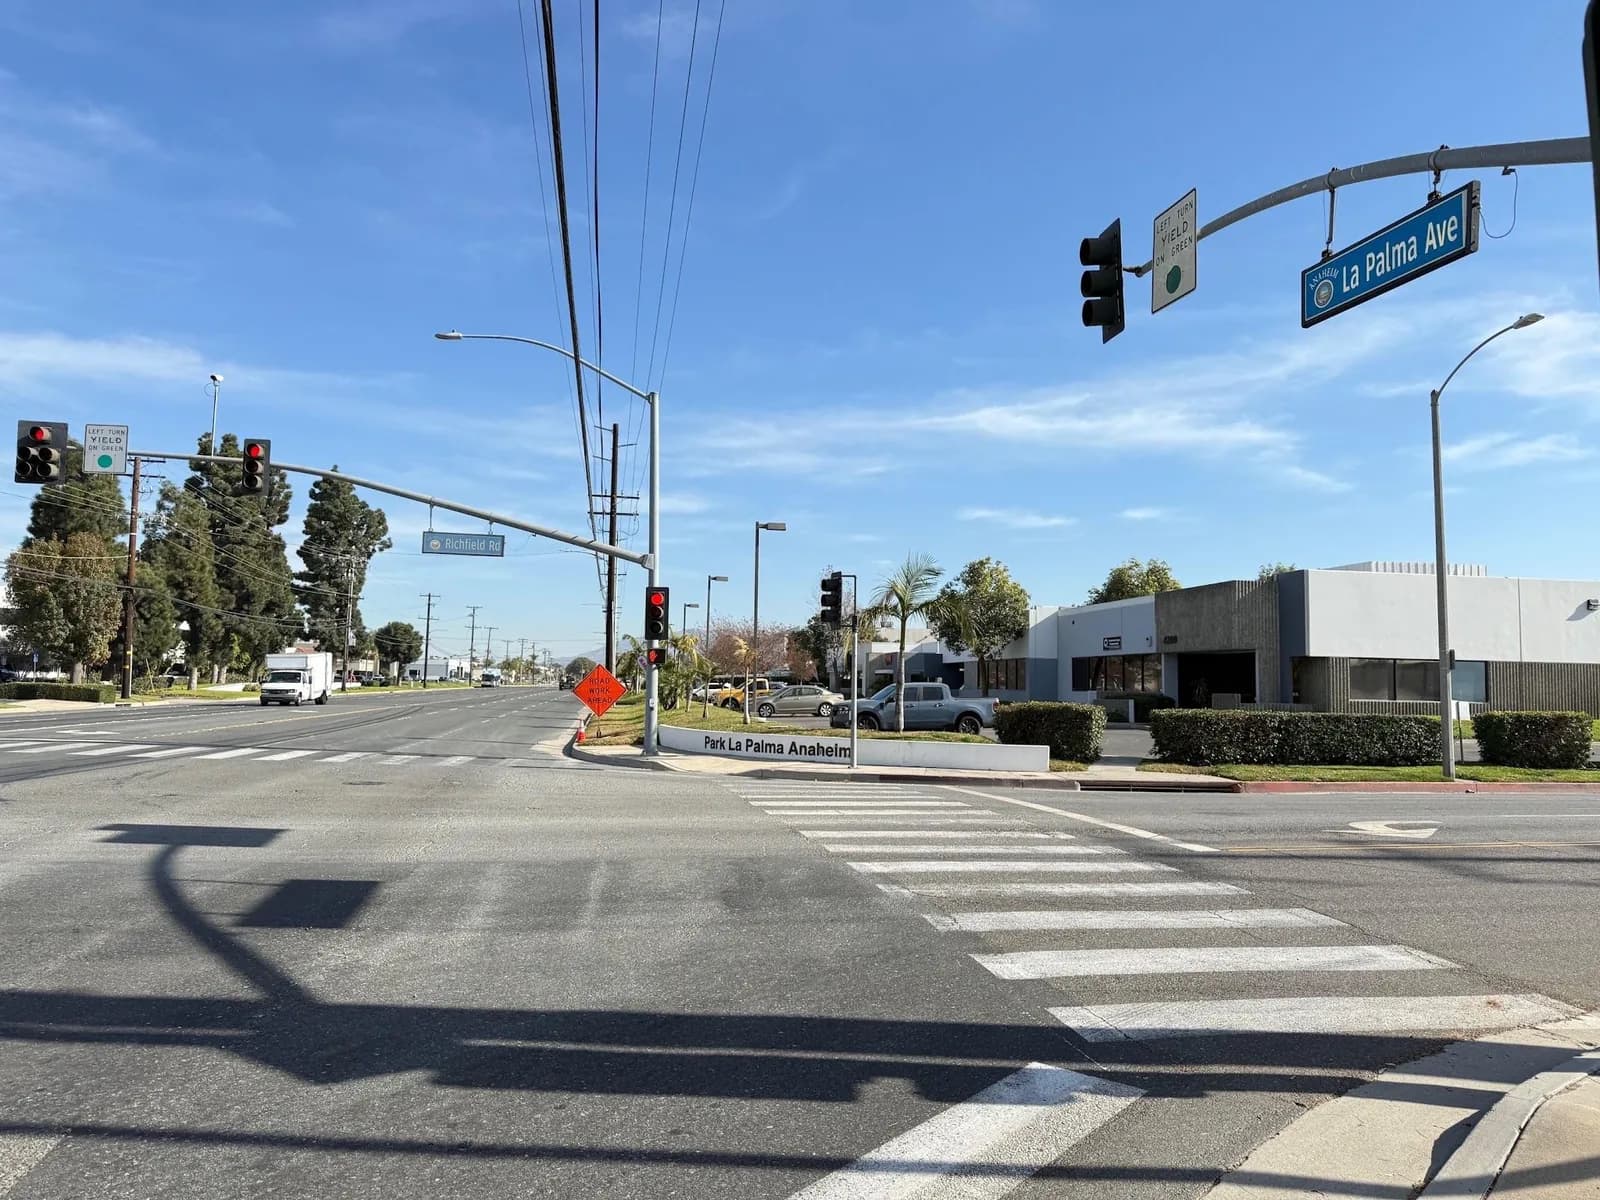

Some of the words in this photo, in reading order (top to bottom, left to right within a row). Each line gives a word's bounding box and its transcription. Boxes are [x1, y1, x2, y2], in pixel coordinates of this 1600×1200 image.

[1156, 217, 1171, 234] LEFT
[1177, 200, 1193, 218] TURN
[1162, 220, 1188, 247] YIELD
[1156, 254, 1165, 267] ON
[1171, 235, 1193, 257] GREEN
[1342, 264, 1359, 293] La
[1366, 235, 1417, 282] Palma
[1425, 215, 1458, 254] Ave
[1309, 267, 1339, 290] ANAHEIM
[91, 436, 122, 444] YIELD
[445, 538, 486, 551] Richfield
[489, 540, 501, 552] Rd
[704, 735, 726, 750] Park
[728, 737, 742, 752] La
[745, 738, 784, 754] Palma
[788, 741, 851, 758] Anaheim
